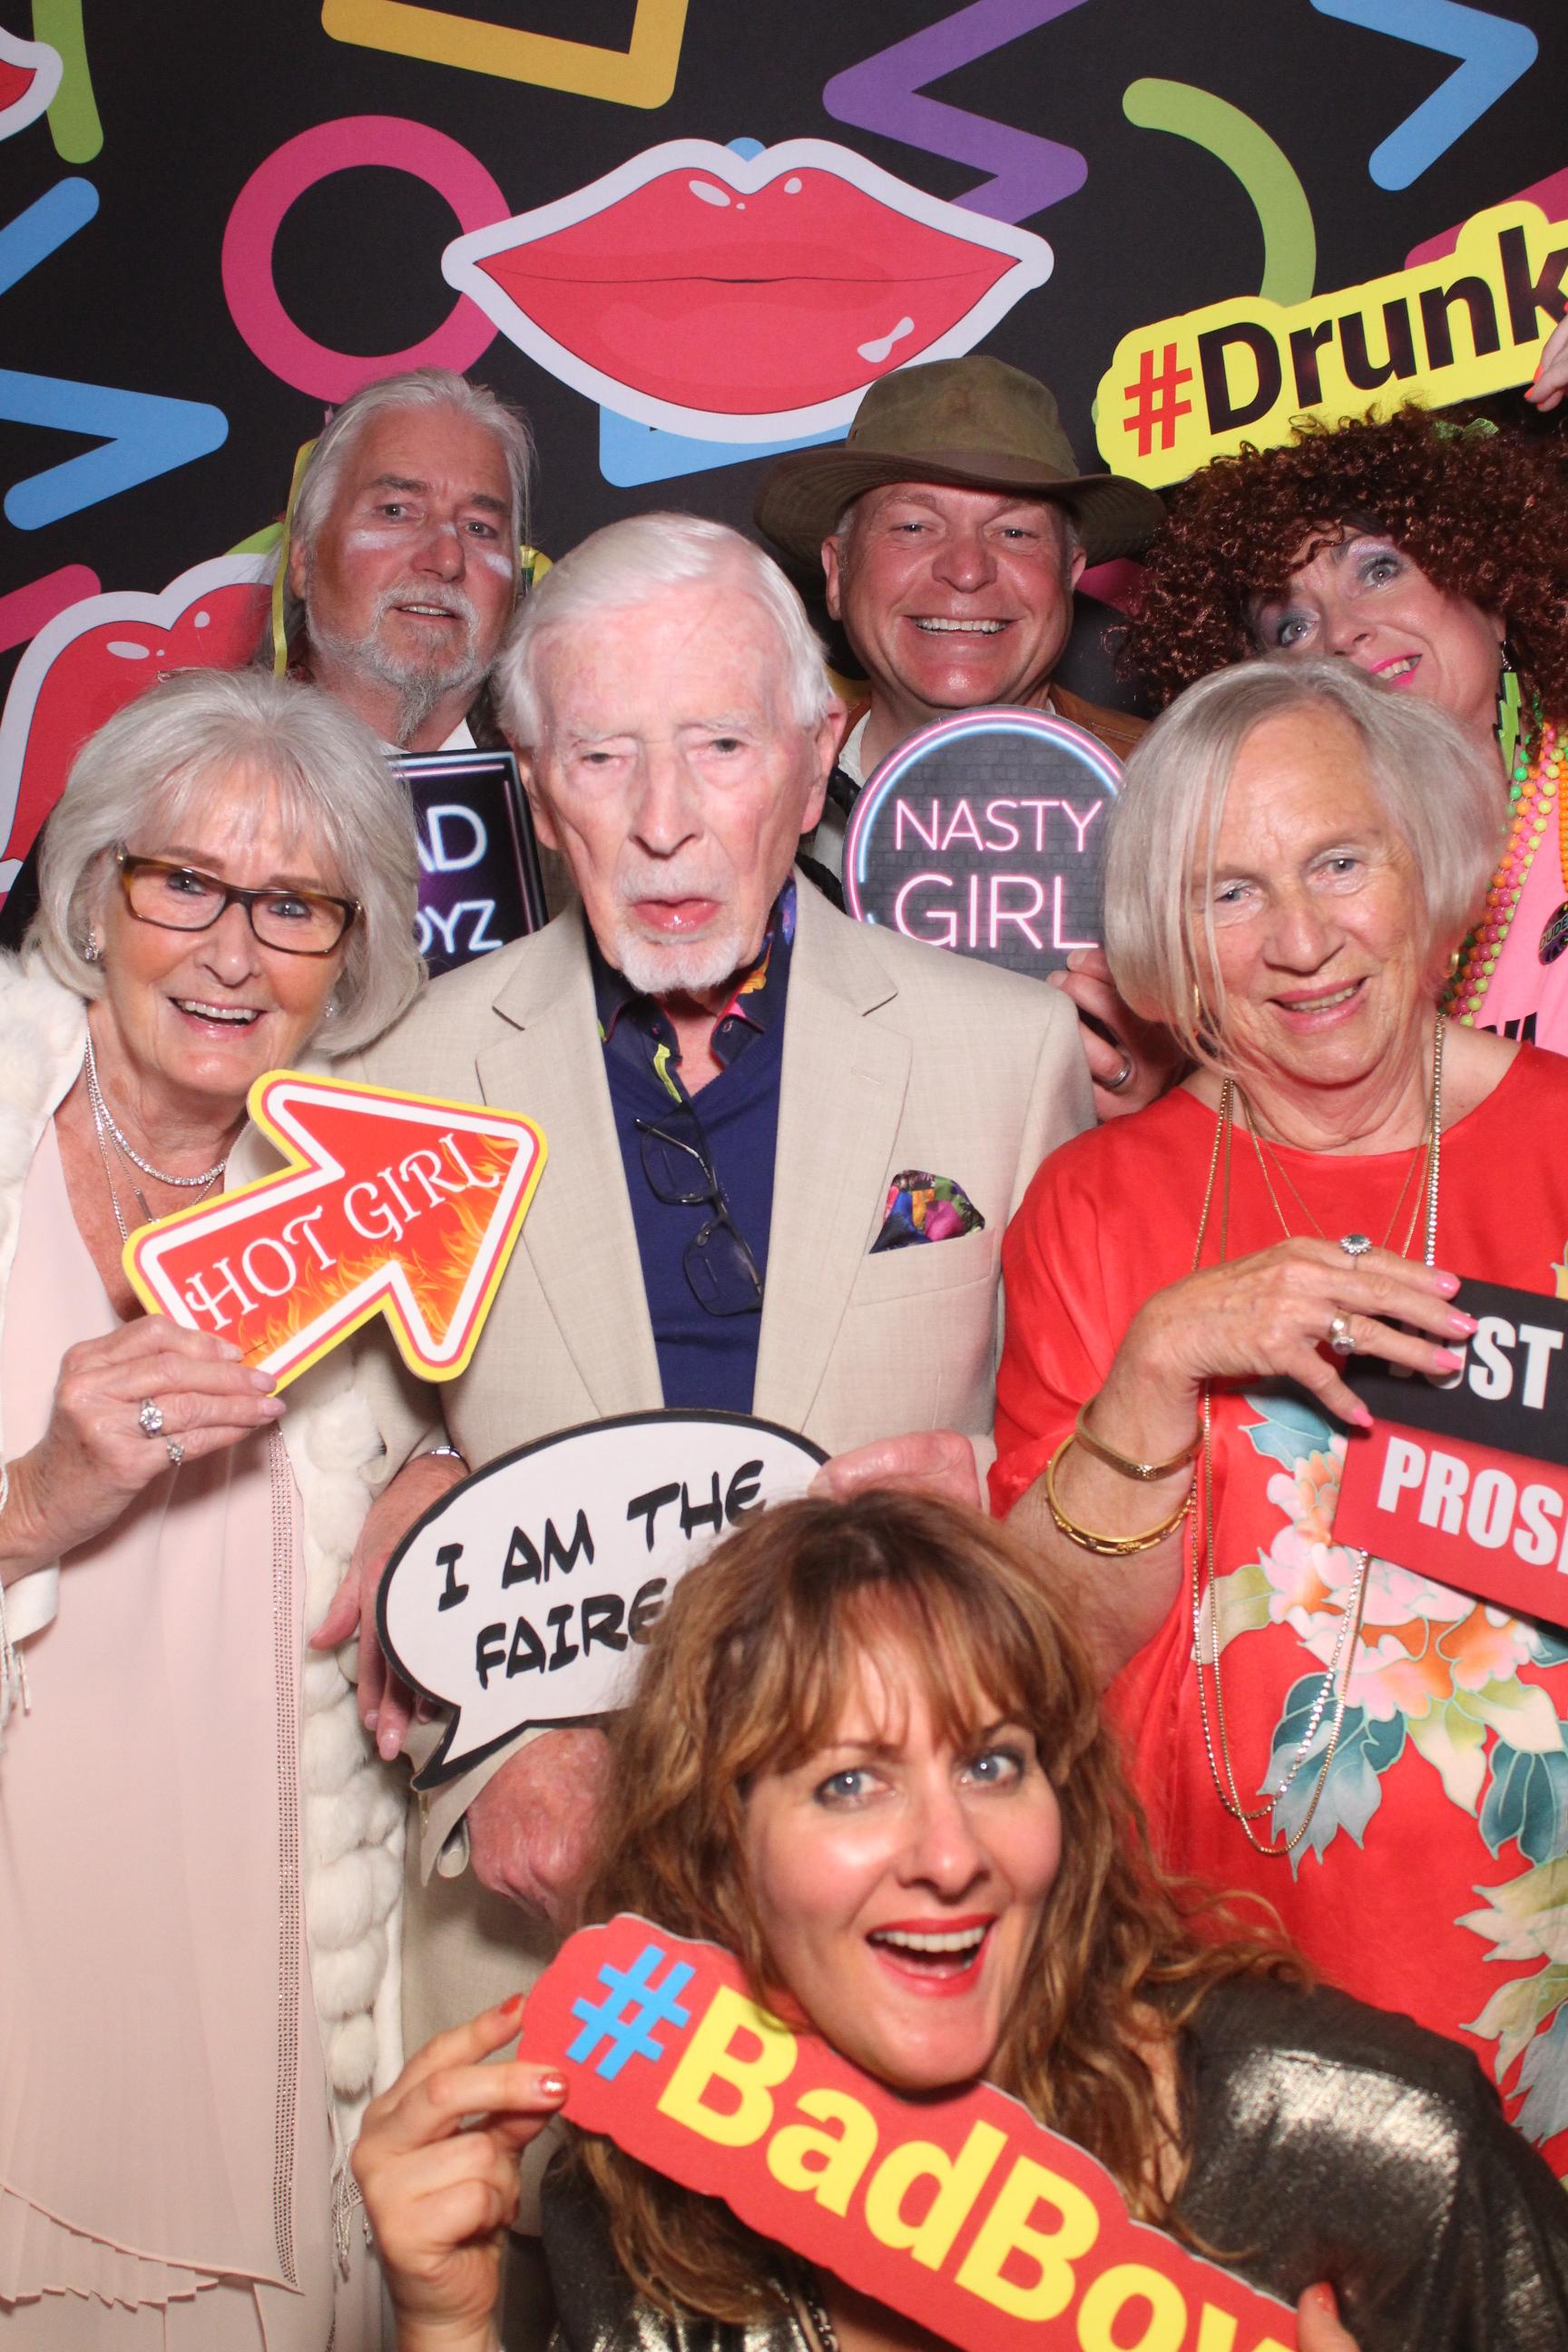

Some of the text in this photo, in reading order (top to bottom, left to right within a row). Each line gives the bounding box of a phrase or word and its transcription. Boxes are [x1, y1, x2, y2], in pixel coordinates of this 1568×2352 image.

[1123, 225, 1568, 457] #Drunk
[896, 799, 1102, 852] NASTY
[895, 874, 1099, 949] GIRL
[184, 1133, 501, 1330] HOT GIRL
[1388, 1313, 1564, 1410] ST
[436, 1460, 767, 1612] I AM THE
[1377, 1436, 1568, 1575] PROS
